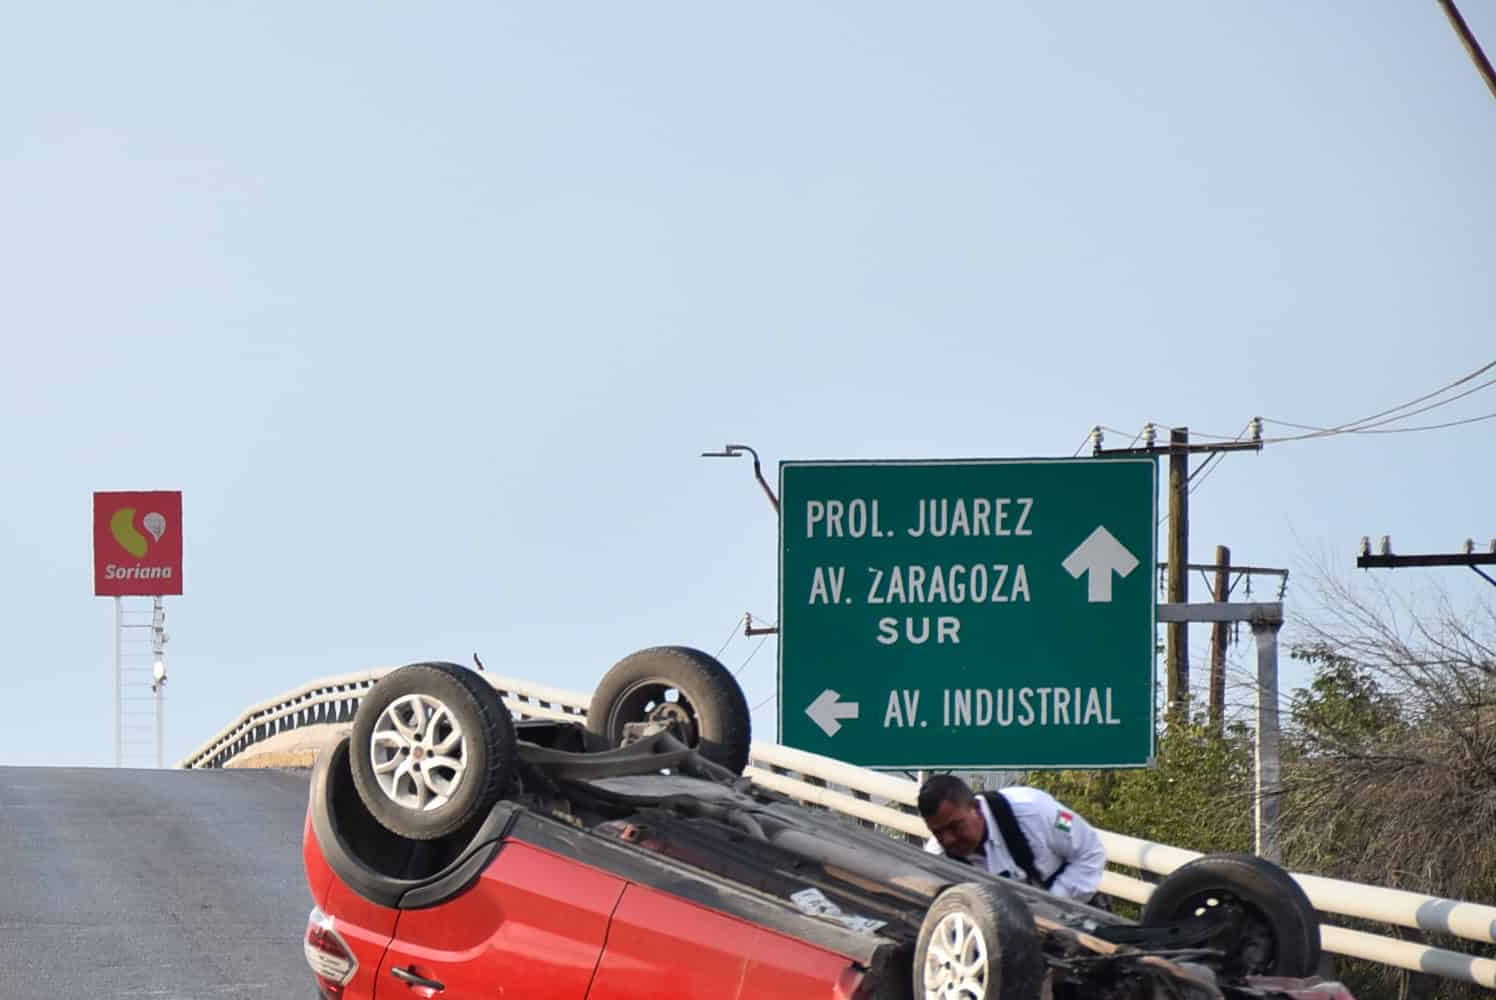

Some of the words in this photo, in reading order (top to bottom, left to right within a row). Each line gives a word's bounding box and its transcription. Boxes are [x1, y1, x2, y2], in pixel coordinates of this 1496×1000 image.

[806, 499, 895, 538] PROL.
[907, 498, 1034, 537] JUAREZ
[104, 563, 172, 580] Soriana
[809, 566, 852, 605] AV.
[867, 564, 1032, 604] ZARAGOZA
[875, 616, 962, 645] SUR
[883, 689, 928, 728] AV.
[943, 687, 1122, 727] INDUSTRIAL
